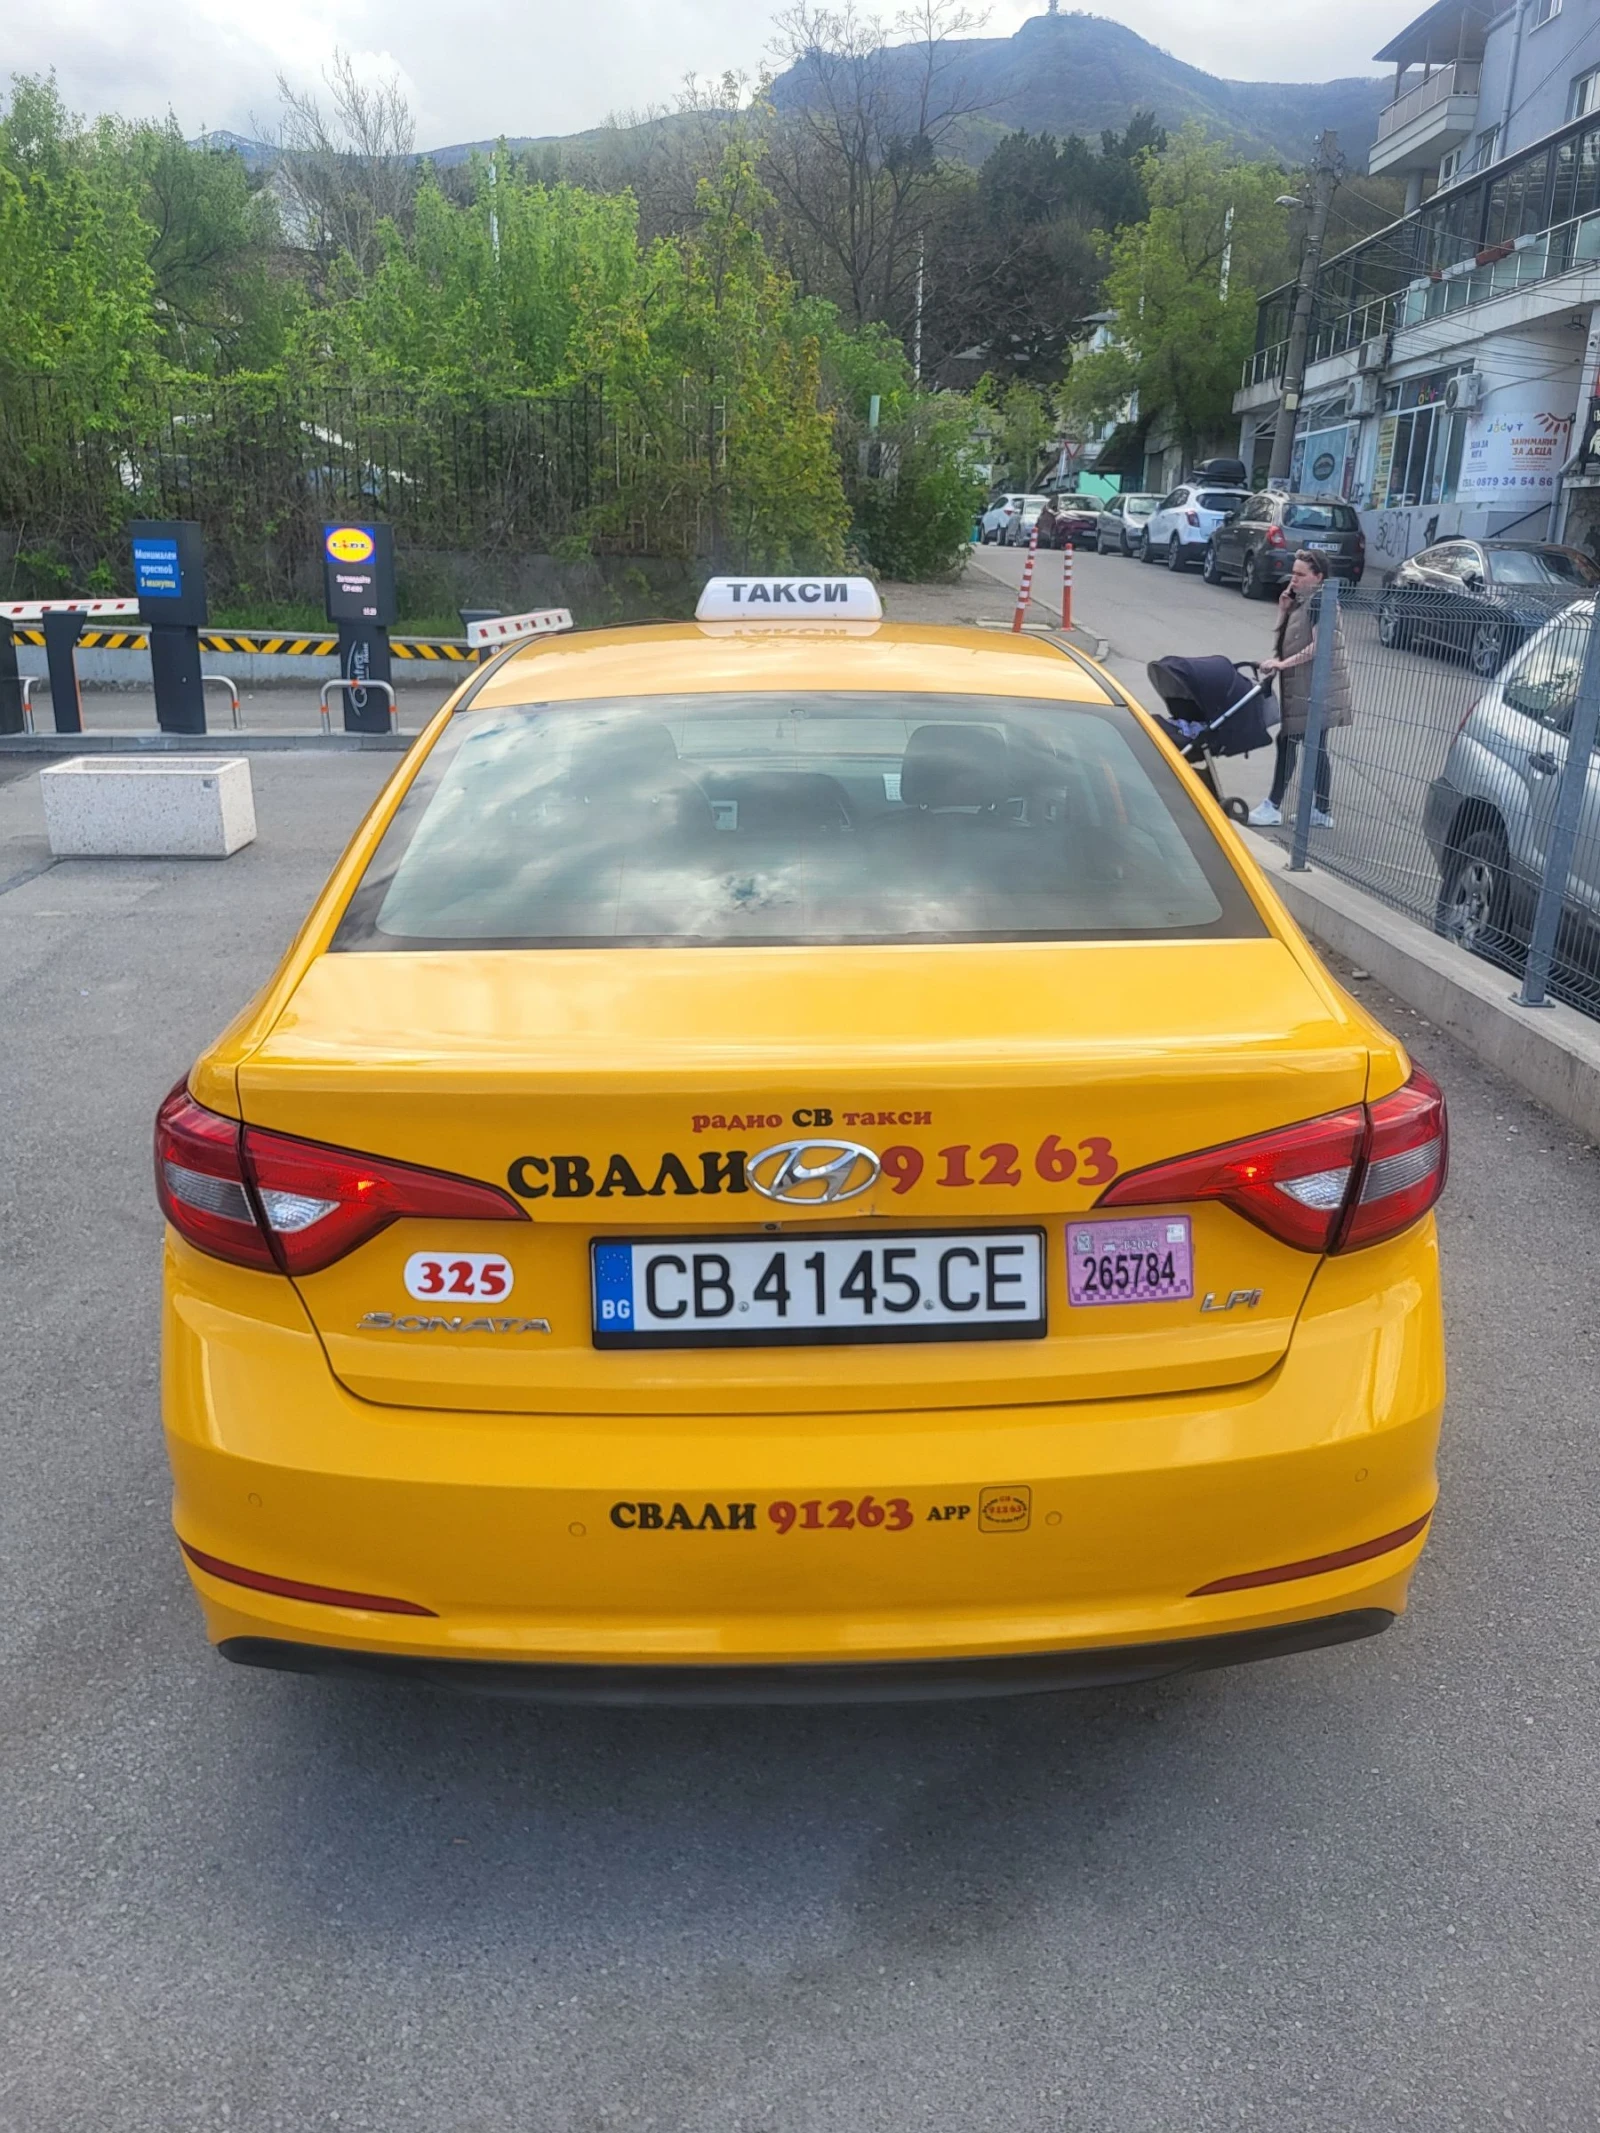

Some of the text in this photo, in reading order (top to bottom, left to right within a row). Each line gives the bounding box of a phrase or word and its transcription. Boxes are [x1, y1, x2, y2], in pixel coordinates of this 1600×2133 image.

[1512, 447, 1552, 456] ЗА ДЕЦА
[1476, 477, 1499, 487] 0879
[1502, 476, 1517, 486] 34
[1520, 476, 1536, 486] 54
[1538, 477, 1553, 486] 86
[727, 583, 848, 603] ТАКСИ
[692, 1112, 783, 1133] радио
[842, 1109, 933, 1127] такси
[507, 1151, 750, 1199] СВАЛИ
[417, 1261, 506, 1296] 325
[1083, 1250, 1176, 1291] 265784
[602, 1299, 630, 1319] BG
[356, 1312, 552, 1334] SONATA
[610, 1502, 757, 1530] СВАЛИ
[767, 1495, 914, 1535] 91263
